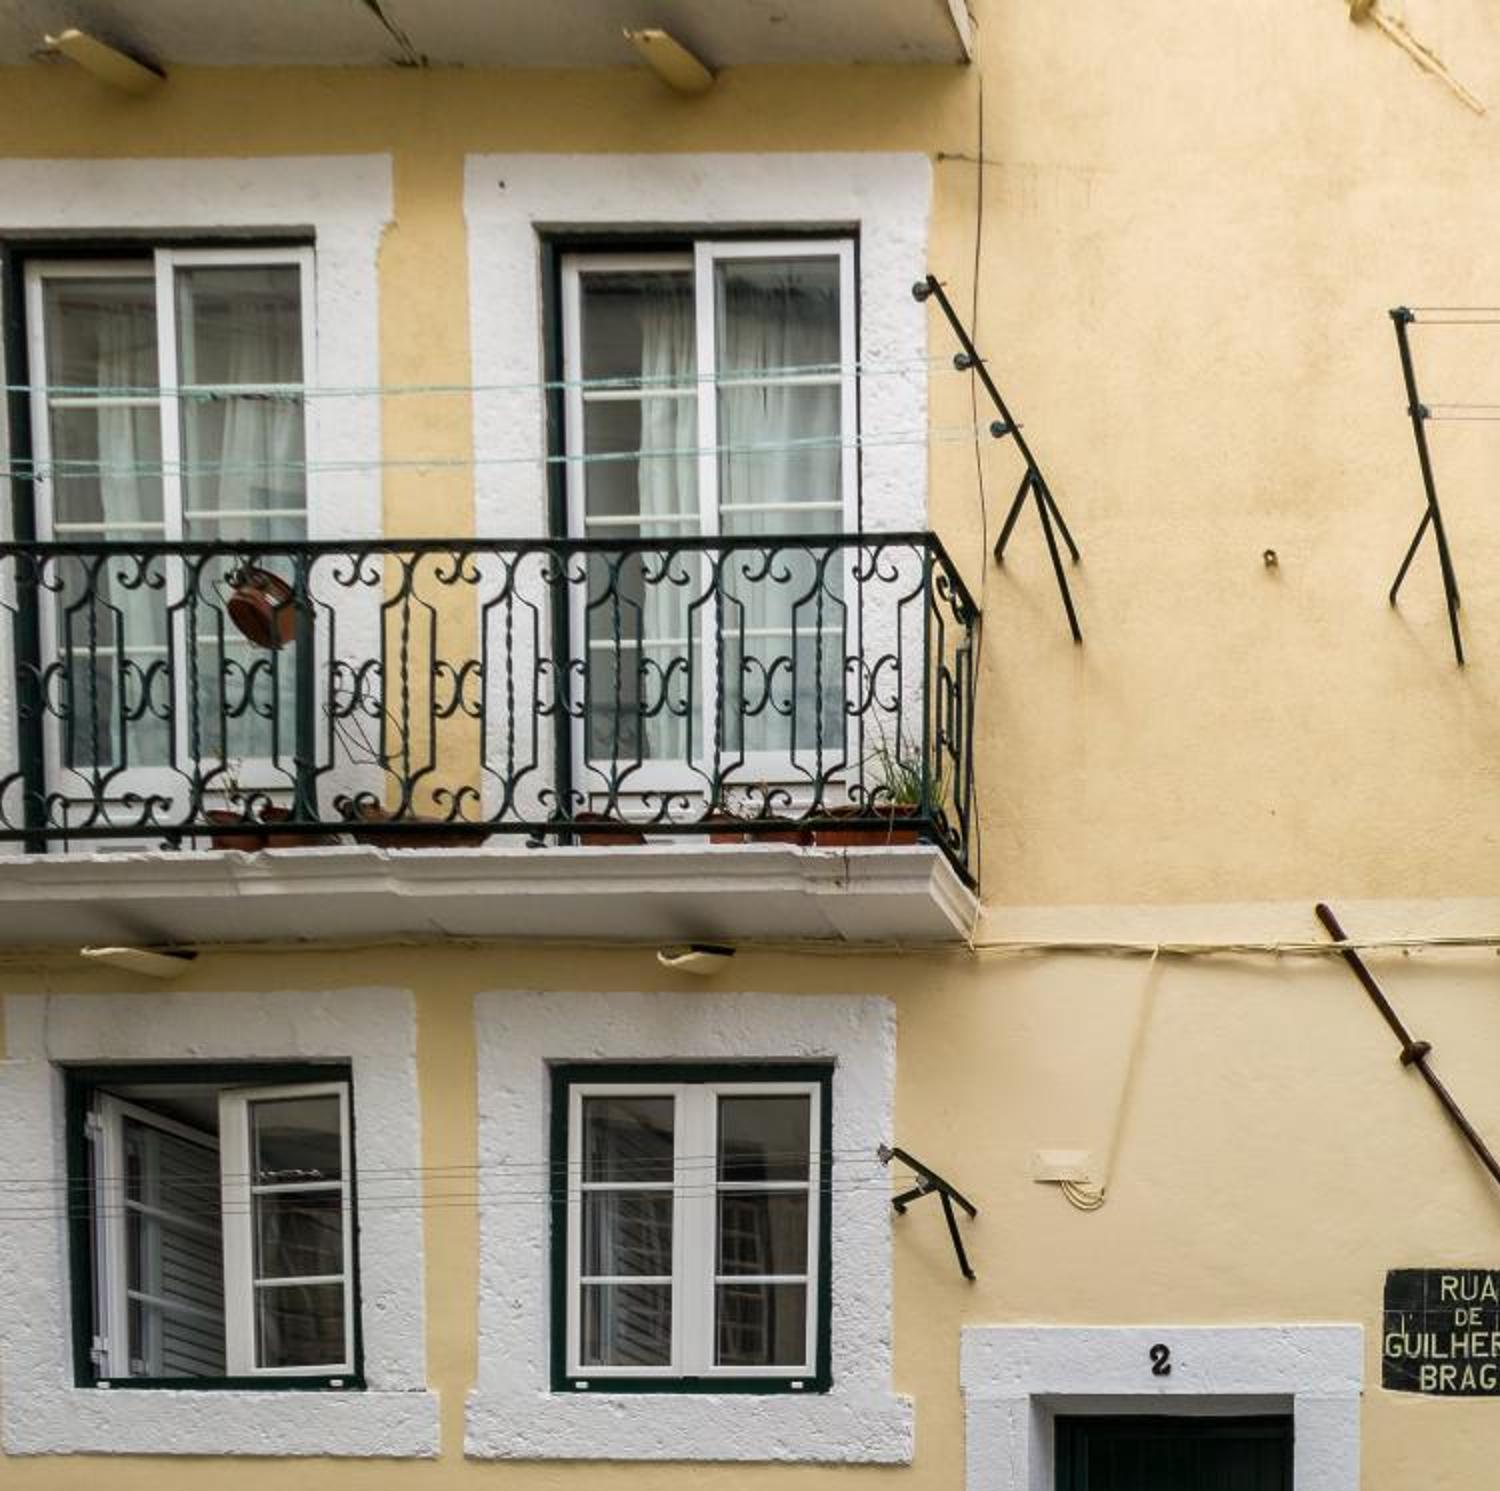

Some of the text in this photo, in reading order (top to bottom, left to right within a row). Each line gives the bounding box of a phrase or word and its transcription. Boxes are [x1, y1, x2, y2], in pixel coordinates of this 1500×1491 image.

[1440, 1275, 1498, 1301] RUA
[1454, 1307, 1483, 1326] DE
[1149, 1343, 1172, 1376] 2
